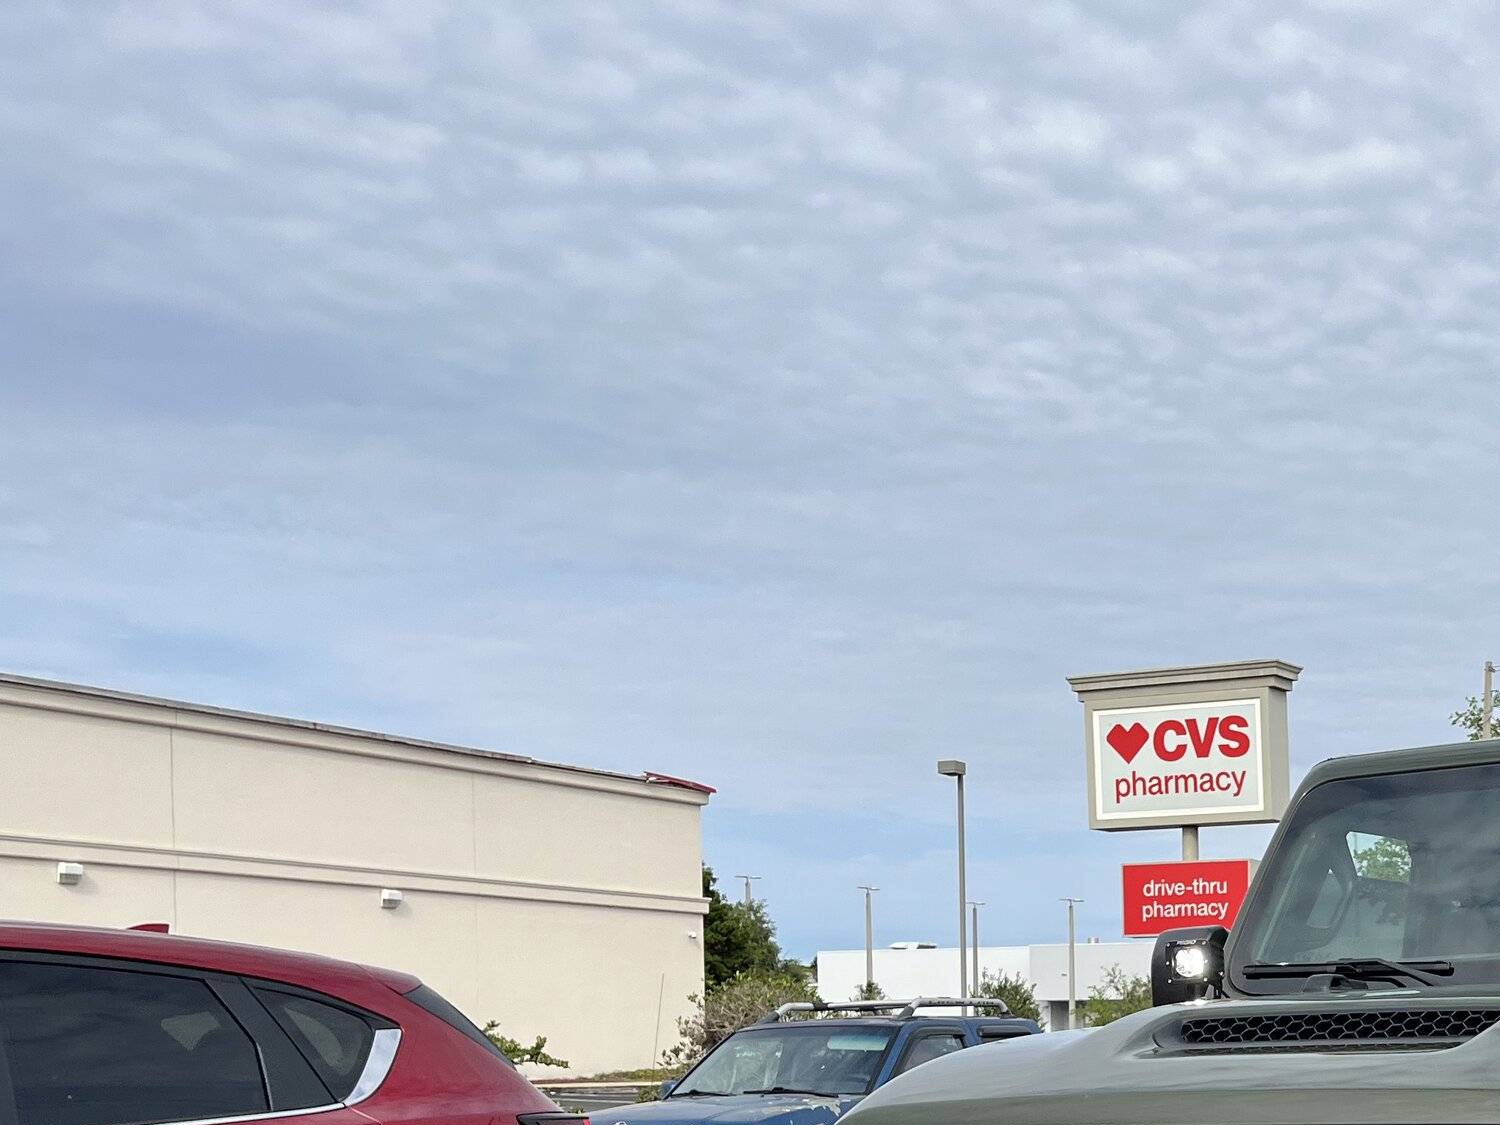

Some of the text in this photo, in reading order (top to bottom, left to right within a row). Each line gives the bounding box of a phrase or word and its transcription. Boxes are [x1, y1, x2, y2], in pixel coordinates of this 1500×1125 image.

[1153, 715, 1250, 762] CVS
[1115, 770, 1247, 803] pharmacy
[1142, 878, 1228, 897] drive-thru
[1141, 900, 1229, 921] pharmacy
